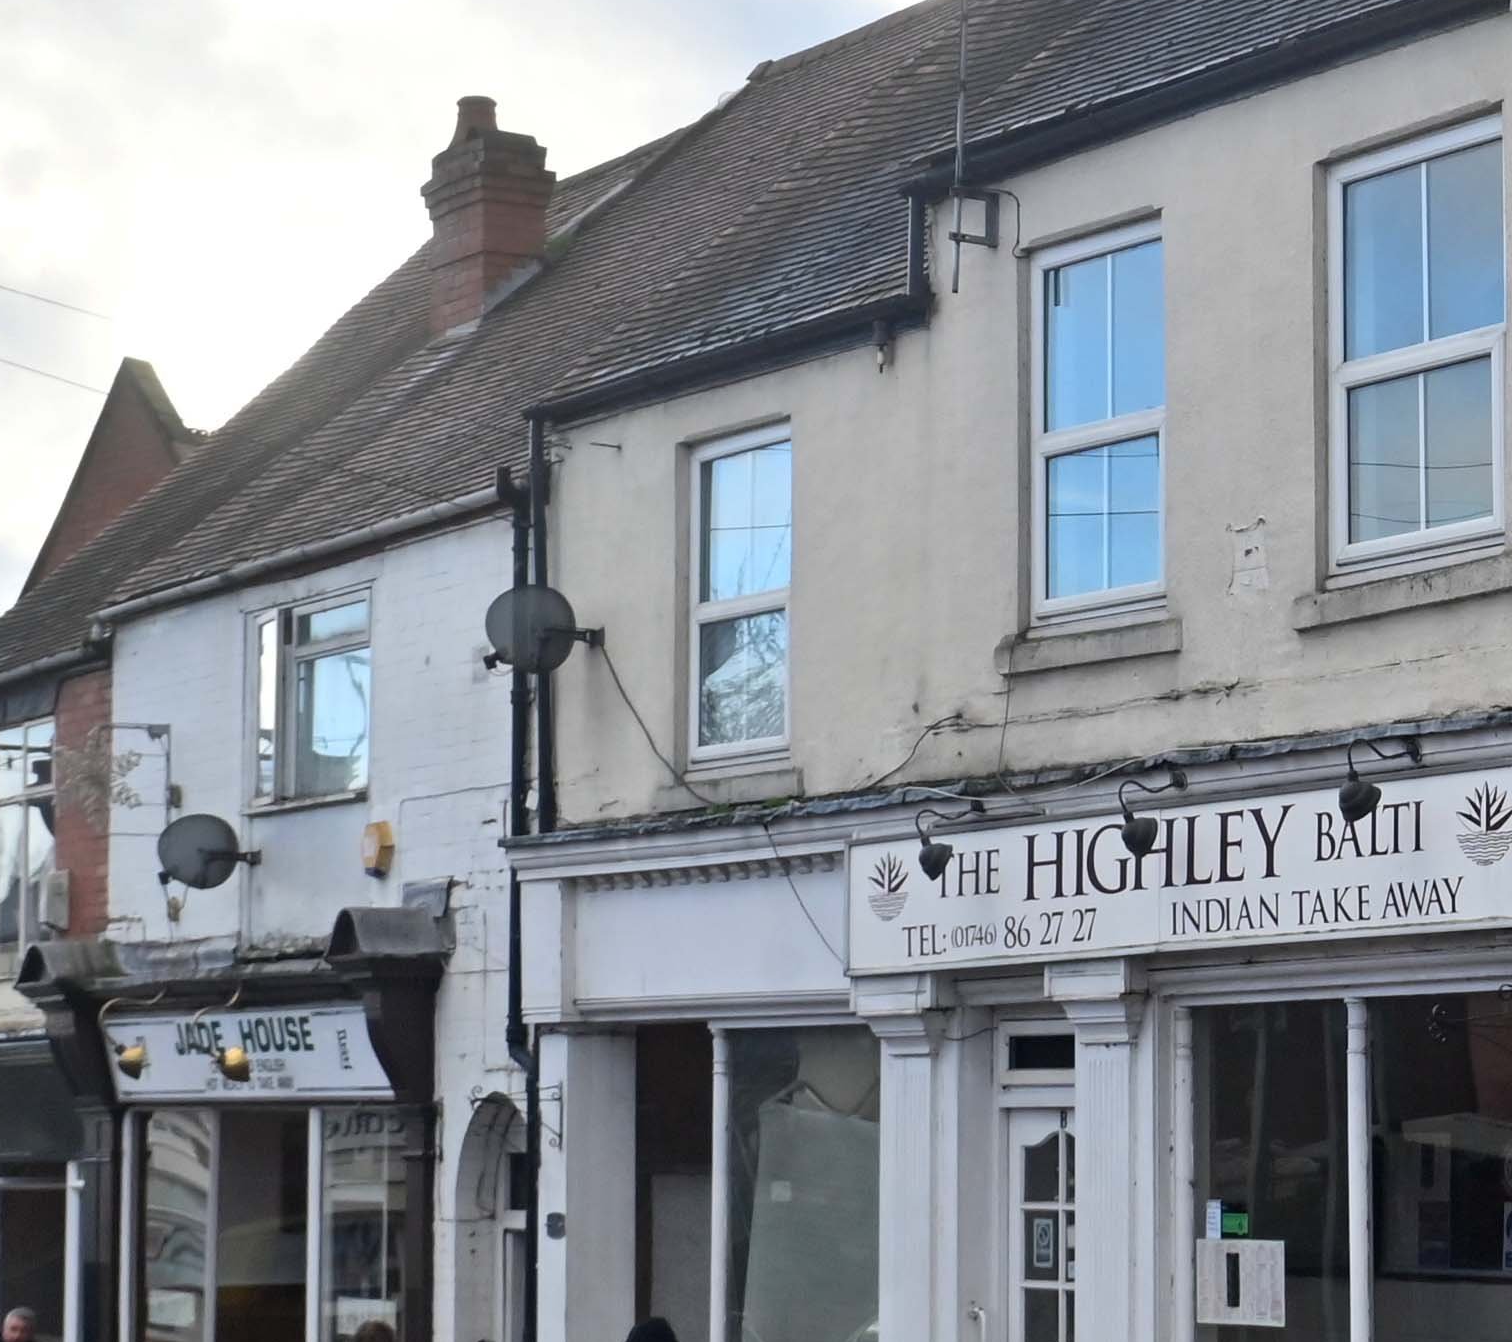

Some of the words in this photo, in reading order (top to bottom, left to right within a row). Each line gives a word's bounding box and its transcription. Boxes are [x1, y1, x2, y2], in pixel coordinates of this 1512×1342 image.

[1023, 803, 1296, 902] HIGHLEY
[1314, 800, 1425, 863] BALTI
[902, 923, 948, 958] TEL:
[951, 922, 998, 949] (01746)
[1004, 914, 1031, 950] 86
[1039, 910, 1064, 946] 27
[1072, 907, 1097, 943] 27
[1171, 892, 1280, 936] INDIAN
[1291, 884, 1371, 927] TAKE
[1381, 875, 1465, 921] AWAY
[175, 1020, 225, 1056] JADE
[239, 1015, 316, 1055] HOUSE
